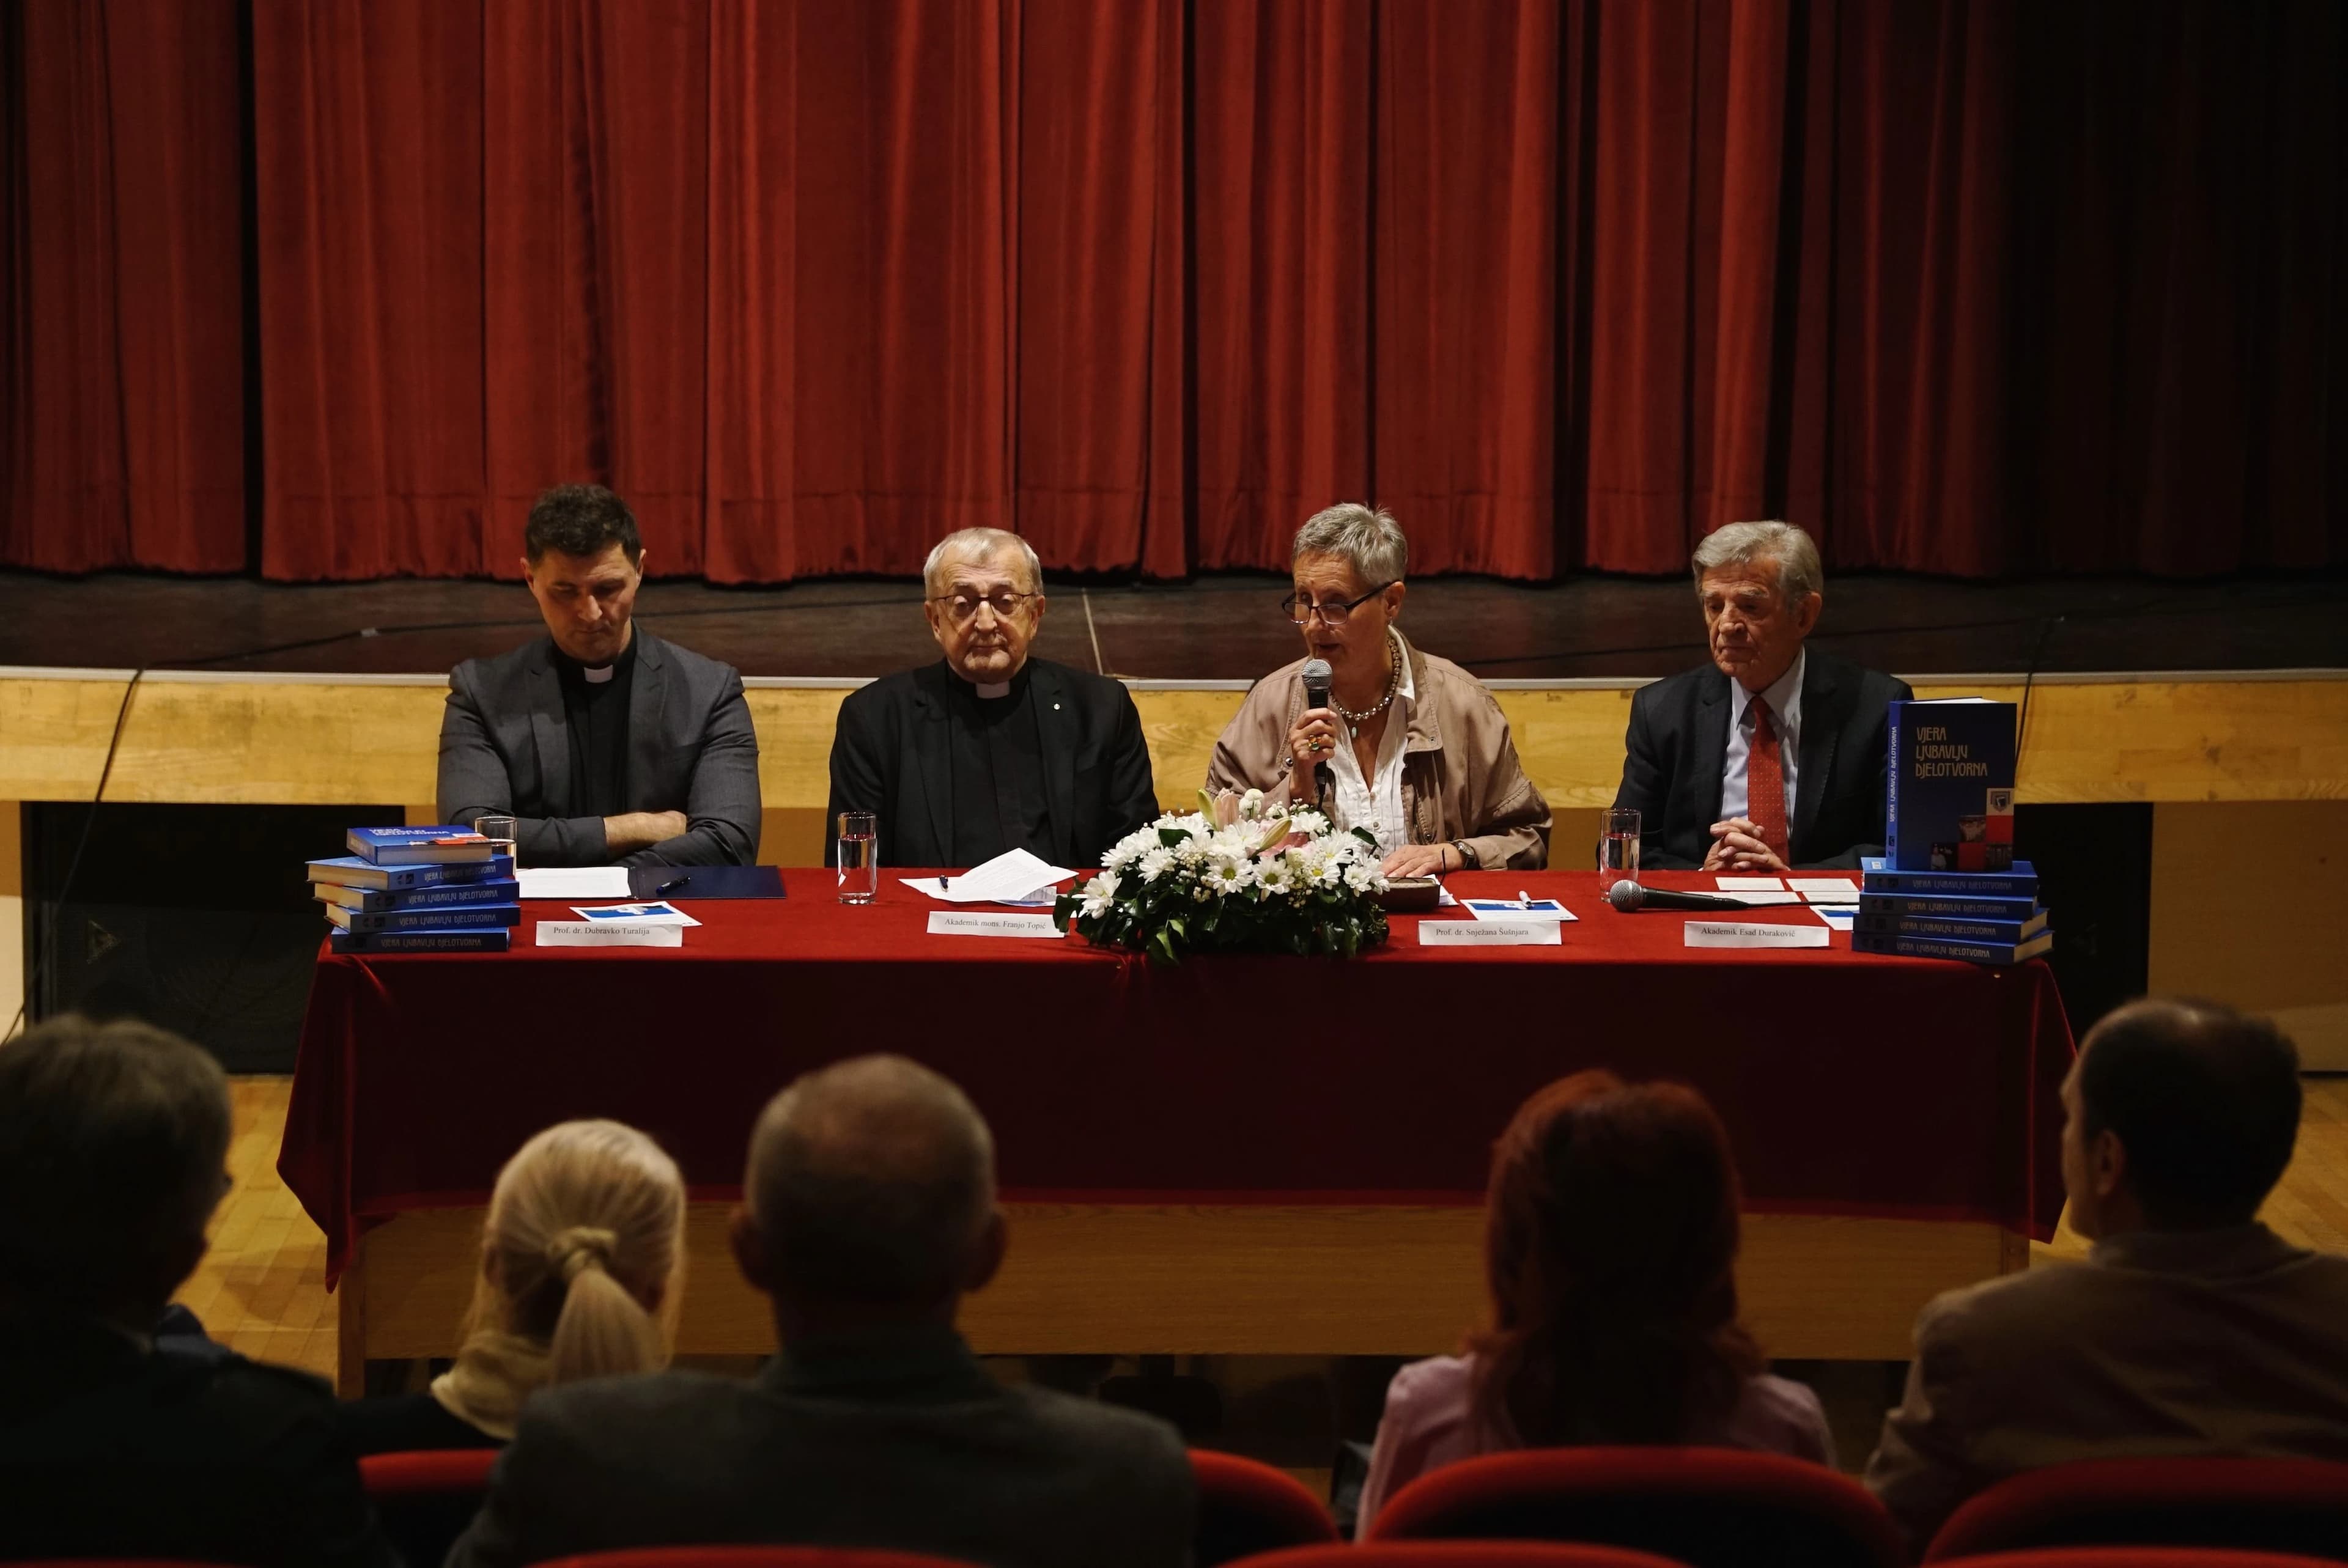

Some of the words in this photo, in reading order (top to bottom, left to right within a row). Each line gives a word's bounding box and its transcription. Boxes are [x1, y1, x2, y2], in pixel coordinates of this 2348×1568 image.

[1916, 726, 1947, 743] VJERA
[1916, 745, 1968, 761] LJUBAVLJU
[1915, 762, 1988, 779] DJELOTVORNA
[408, 894, 426, 905] VJERA
[427, 893, 457, 904] LJUBAVLJU
[459, 890, 498, 901] DJELOTVORNA
[1907, 902, 1926, 911] VJERA
[399, 918, 418, 927] VJERA
[420, 916, 452, 926] LJUBAVLJU
[454, 914, 497, 925] DJELOTVORNA
[1003, 921, 1025, 930] Franjo
[1027, 922, 1046, 930] Topić
[622, 927, 650, 936] Turalija
[1466, 929, 1497, 937] Snježana
[1499, 927, 1529, 937] Šušnjara
[1899, 922, 1918, 930] VJERA
[1954, 926, 1996, 936] DJELOTVORNA
[1949, 948, 1990, 959] DJELOTVORNA
